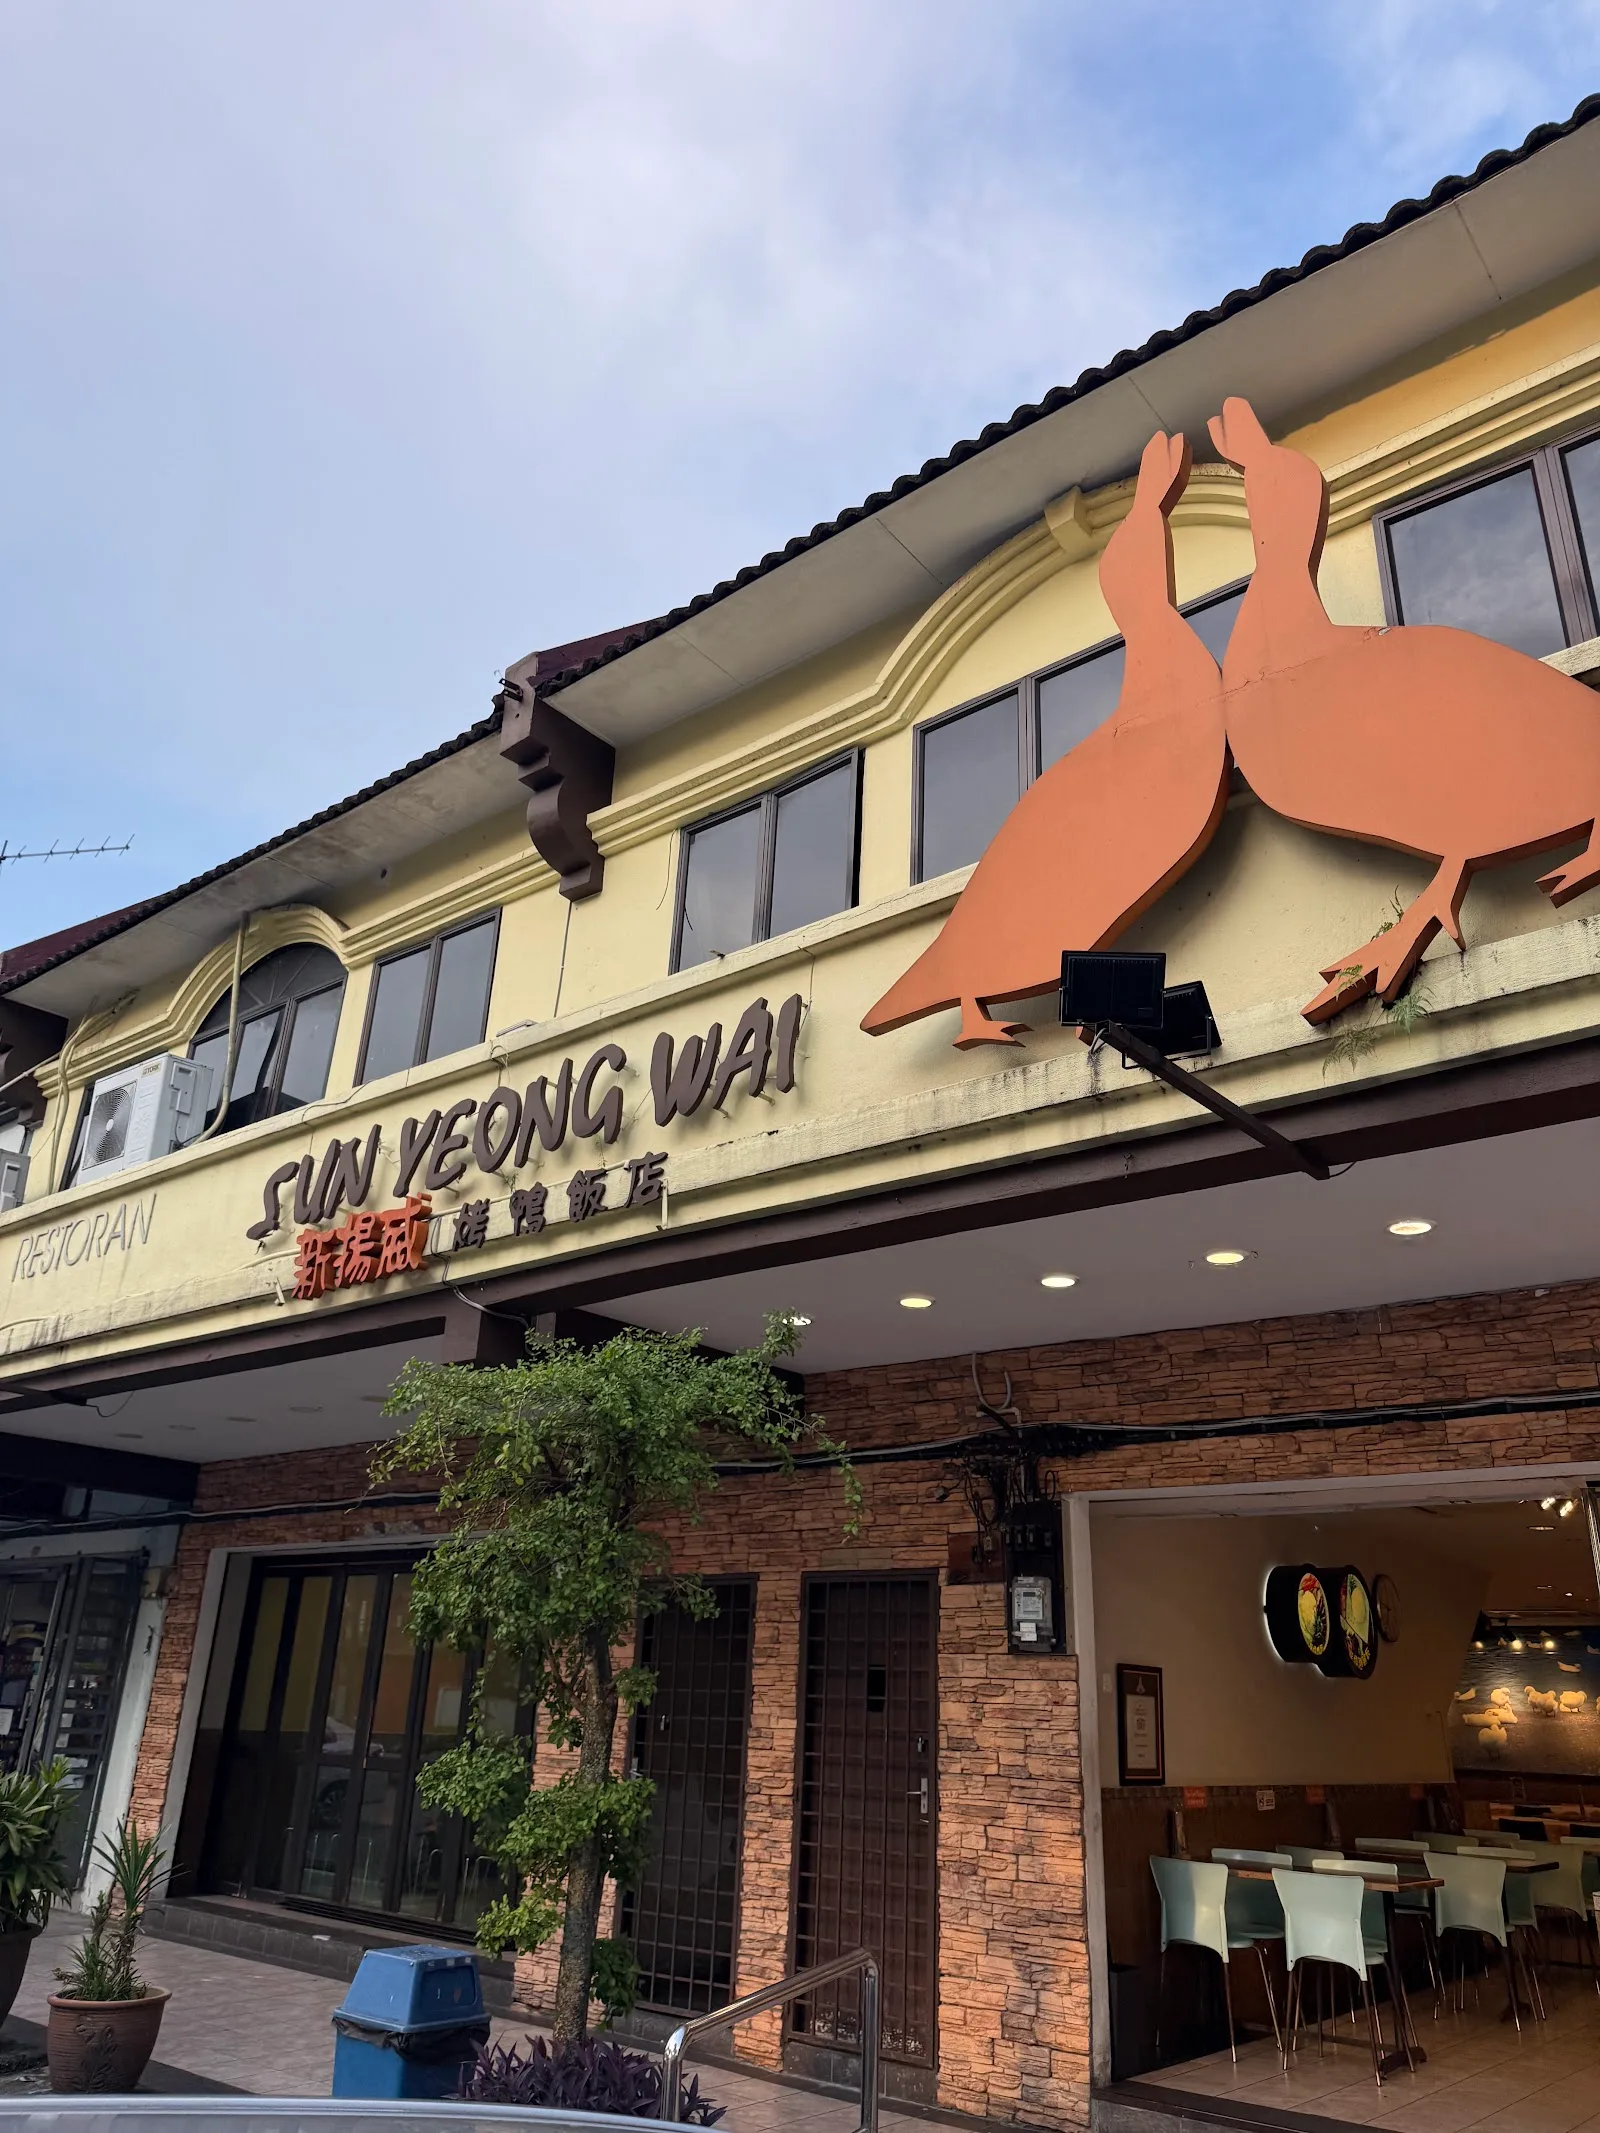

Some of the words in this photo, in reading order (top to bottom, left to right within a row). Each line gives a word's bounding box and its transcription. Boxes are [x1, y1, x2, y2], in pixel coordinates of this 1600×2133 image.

[247, 1123, 382, 1240] SUN
[393, 1043, 627, 1197] YEONG
[650, 993, 804, 1127] WAI
[11, 1193, 157, 1283] RESTORAN
